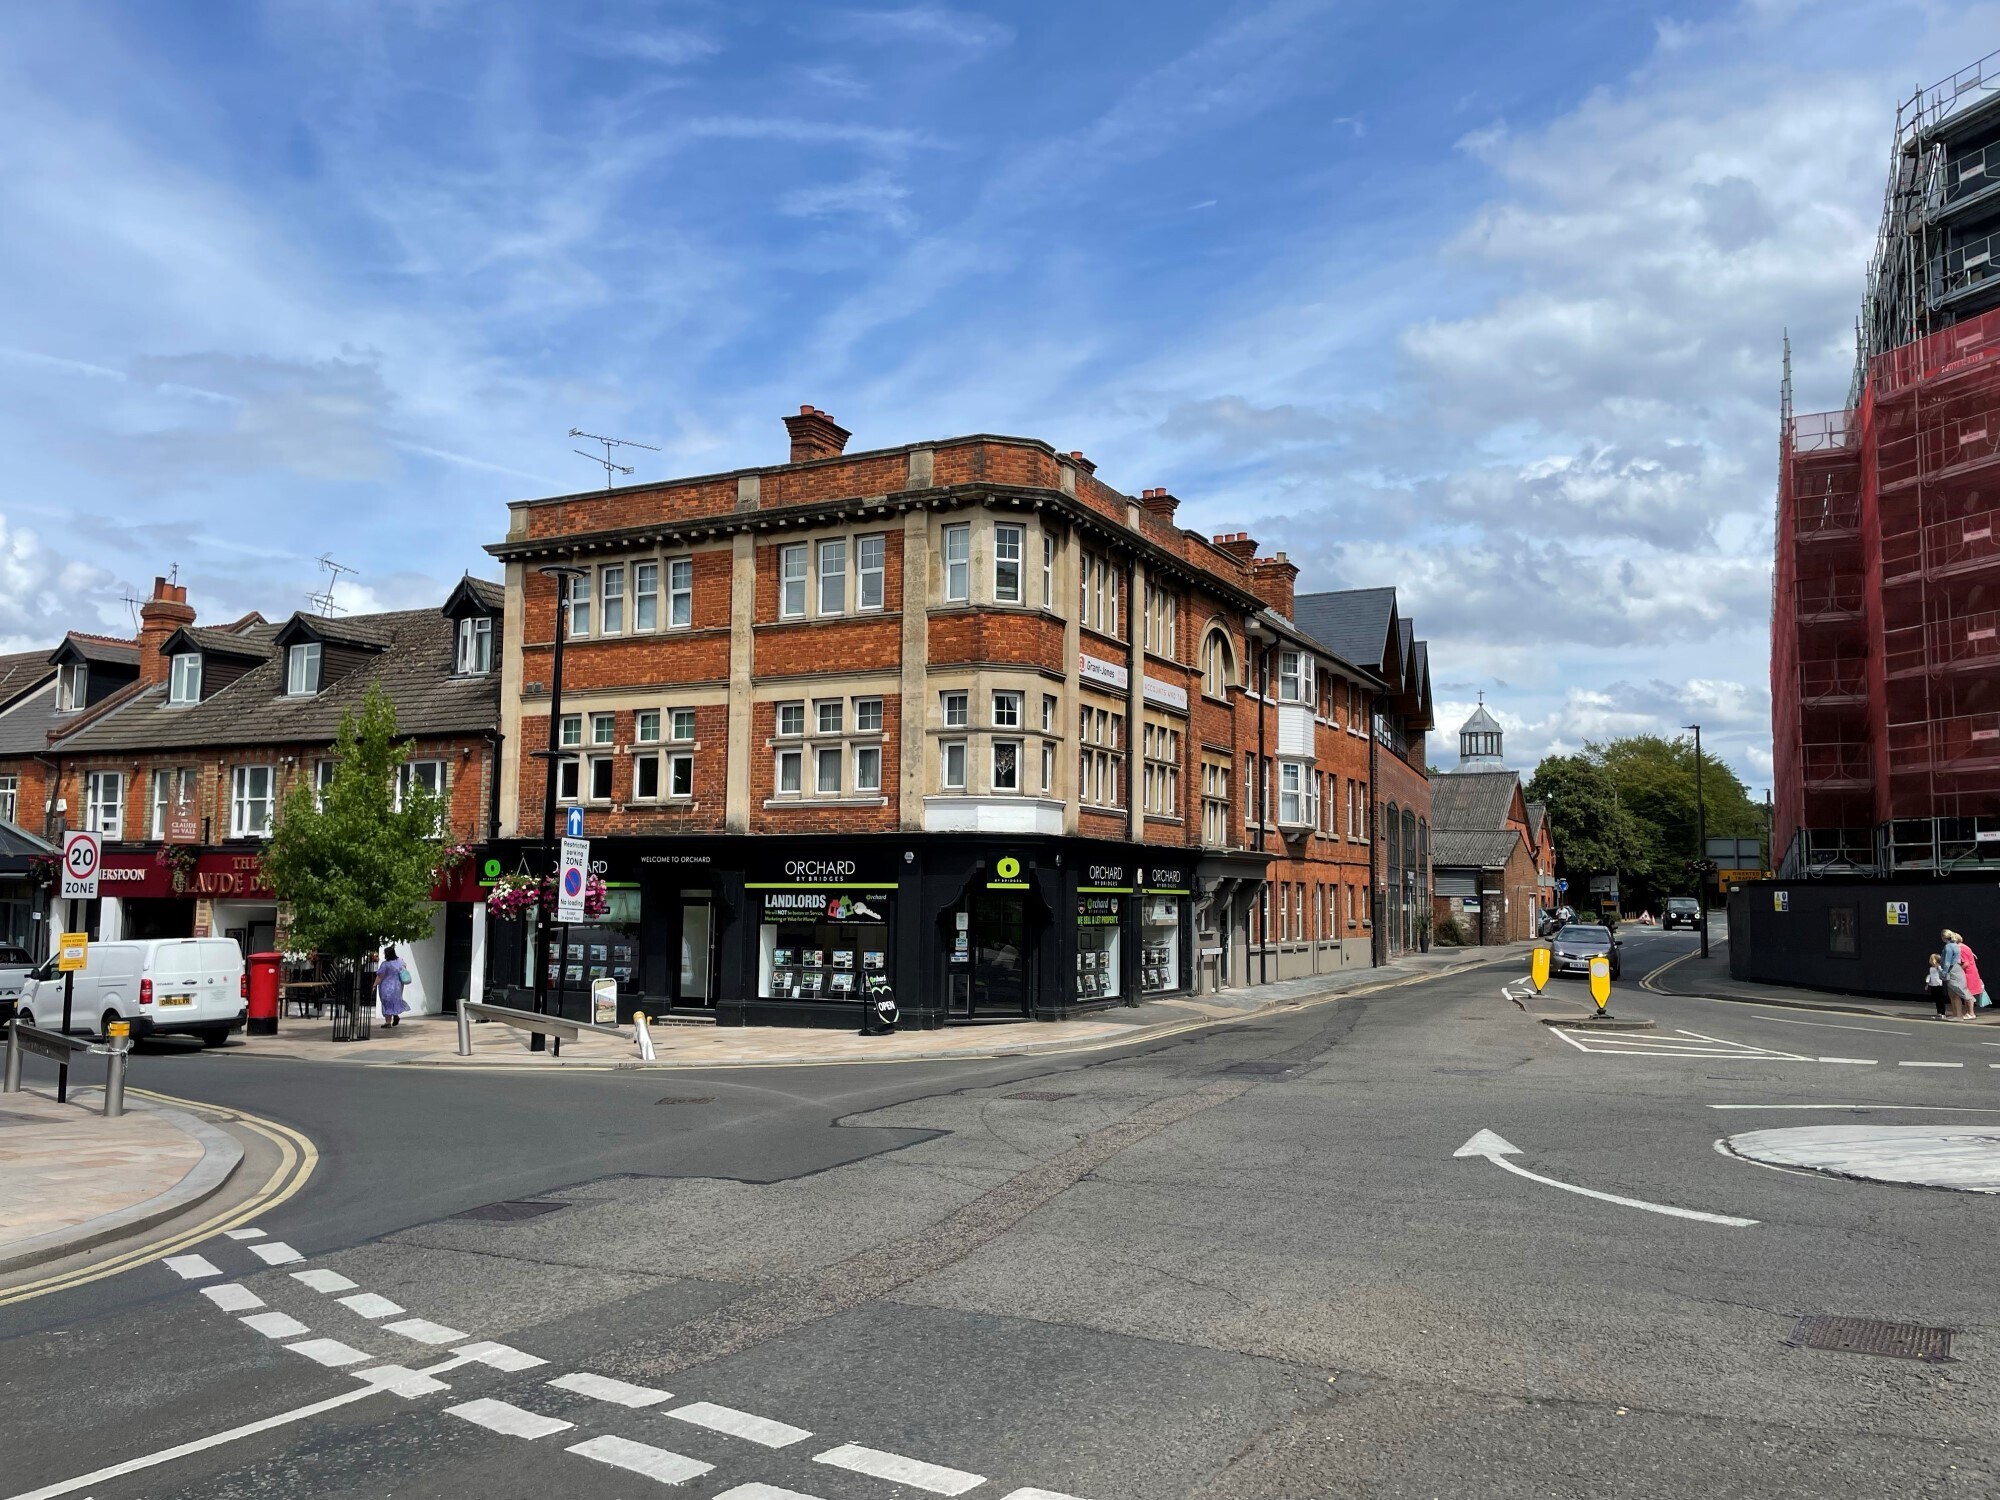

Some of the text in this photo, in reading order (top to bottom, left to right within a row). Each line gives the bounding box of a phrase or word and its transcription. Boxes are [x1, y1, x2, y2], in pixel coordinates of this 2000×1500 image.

[1086, 660, 1115, 678] Grant-Jones
[1144, 683, 1166, 697] ACCOUNTS
[1167, 690, 1176, 700] AND
[563, 841, 588, 850] Restricted
[71, 848, 94, 866] 20
[566, 850, 584, 858] parking
[232, 857, 257, 870] THE
[565, 856, 583, 867] ZONE
[785, 861, 856, 875] ORCHARD
[1089, 865, 1123, 880] ORCHARD
[1151, 869, 1181, 883] ORCHARD
[65, 882, 94, 894] ZONE
[567, 899, 584, 908] loading
[765, 894, 827, 909] LANDLORDS
[1086, 897, 1109, 910] Orchard
[878, 1000, 896, 1012] OPEN
